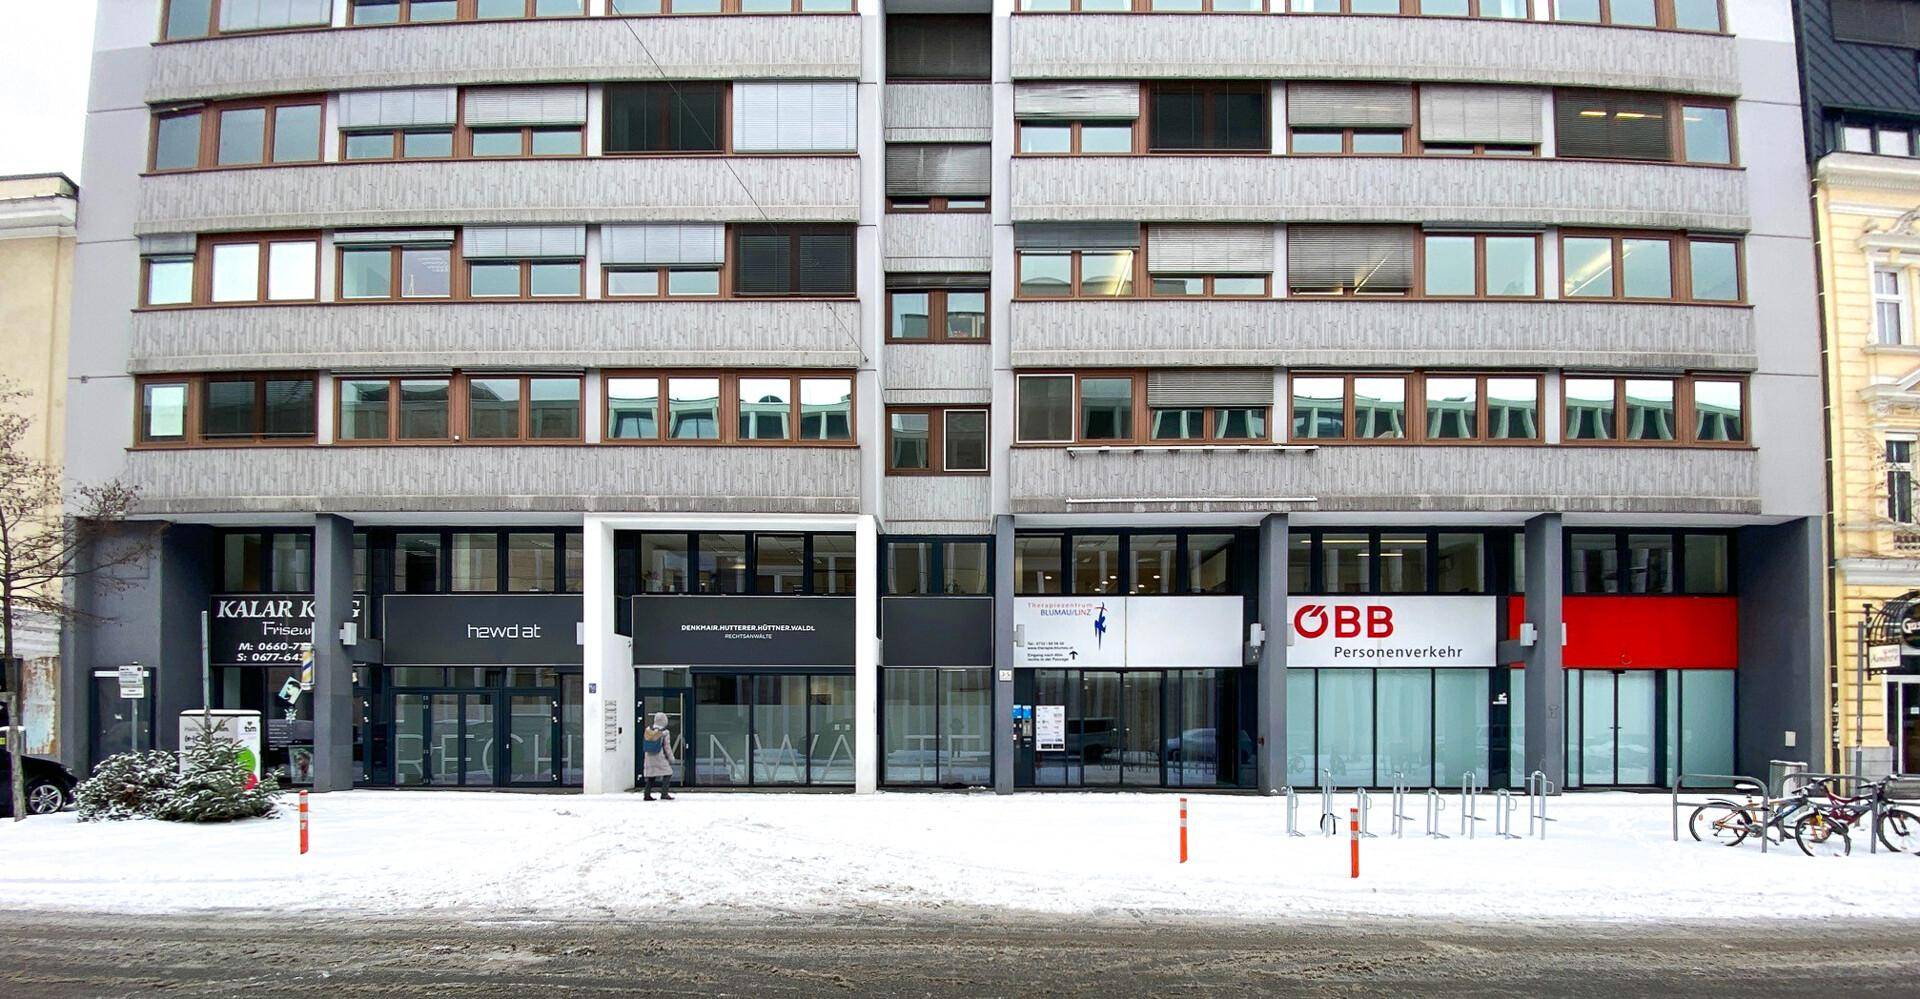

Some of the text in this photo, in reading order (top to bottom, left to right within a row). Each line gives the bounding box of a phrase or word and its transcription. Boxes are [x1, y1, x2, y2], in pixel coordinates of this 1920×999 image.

[217, 600, 293, 618] KALAR
[1294, 604, 1394, 638] ÖBB
[238, 642, 254, 651] M:
[1334, 646, 1463, 658] Personenverkehr
[236, 652, 248, 662] S:
